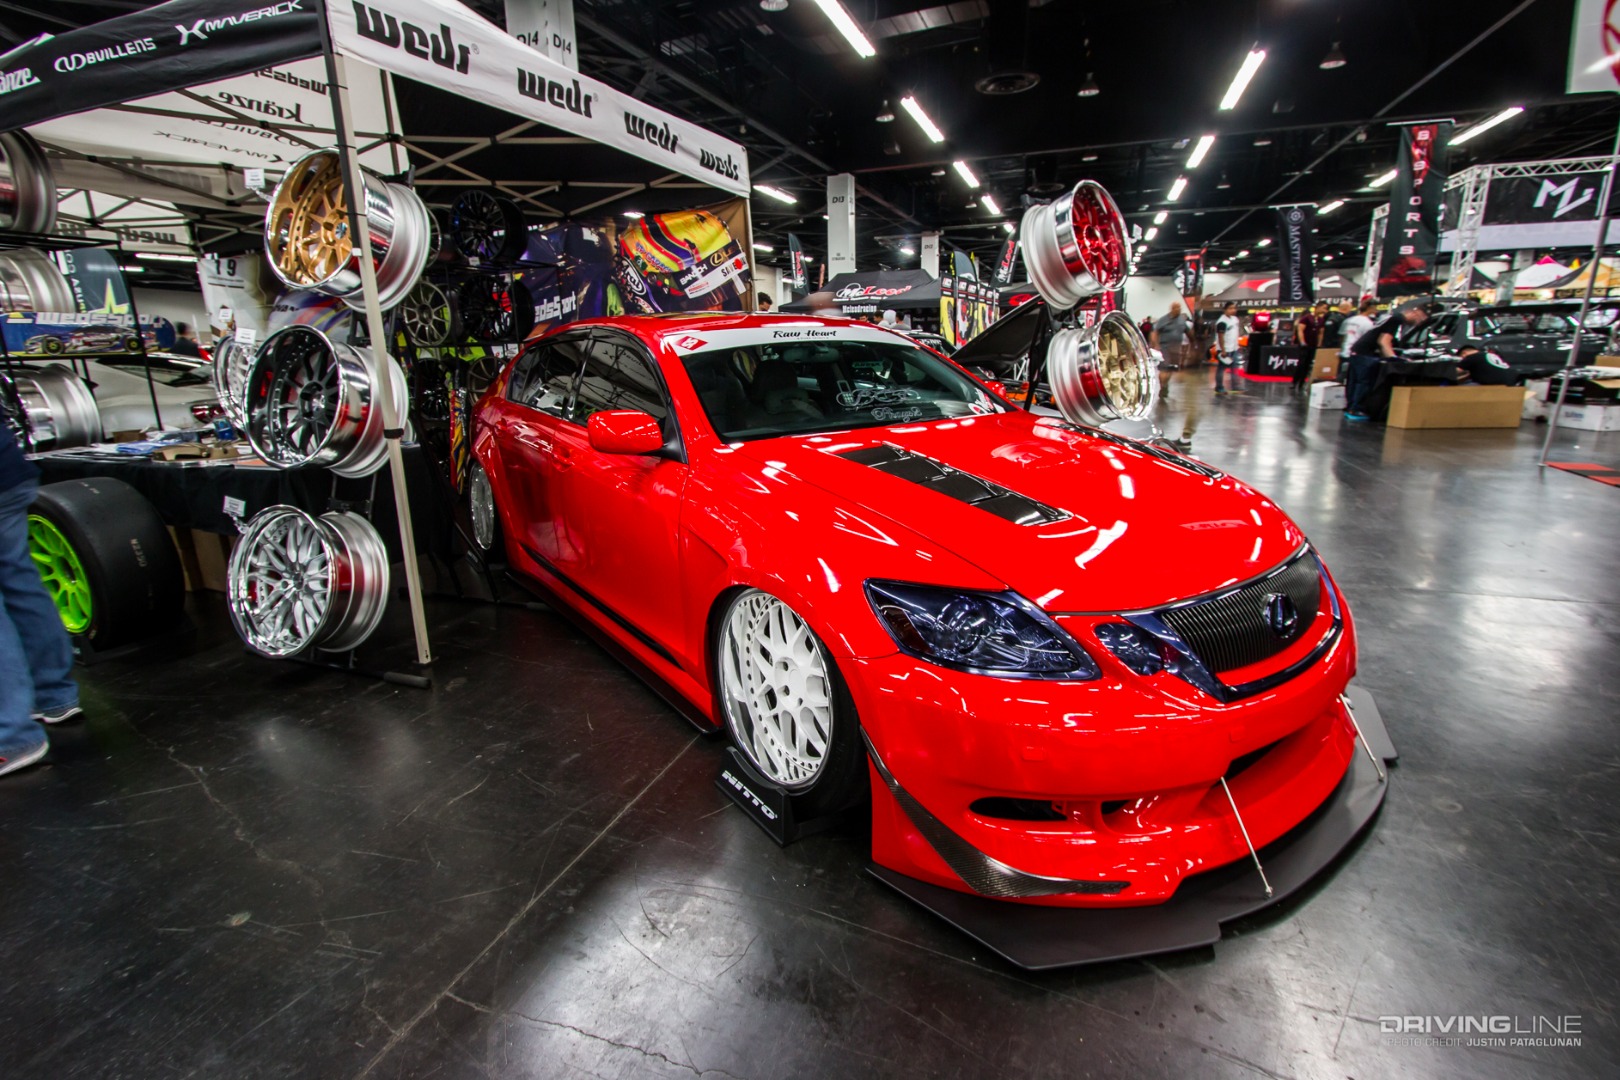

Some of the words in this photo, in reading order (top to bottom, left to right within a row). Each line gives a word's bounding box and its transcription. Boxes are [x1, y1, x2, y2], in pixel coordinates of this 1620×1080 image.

[204, 0, 303, 32] MAVERICK
[553, 33, 571, 54] D14
[722, 769, 776, 820] NITTO
